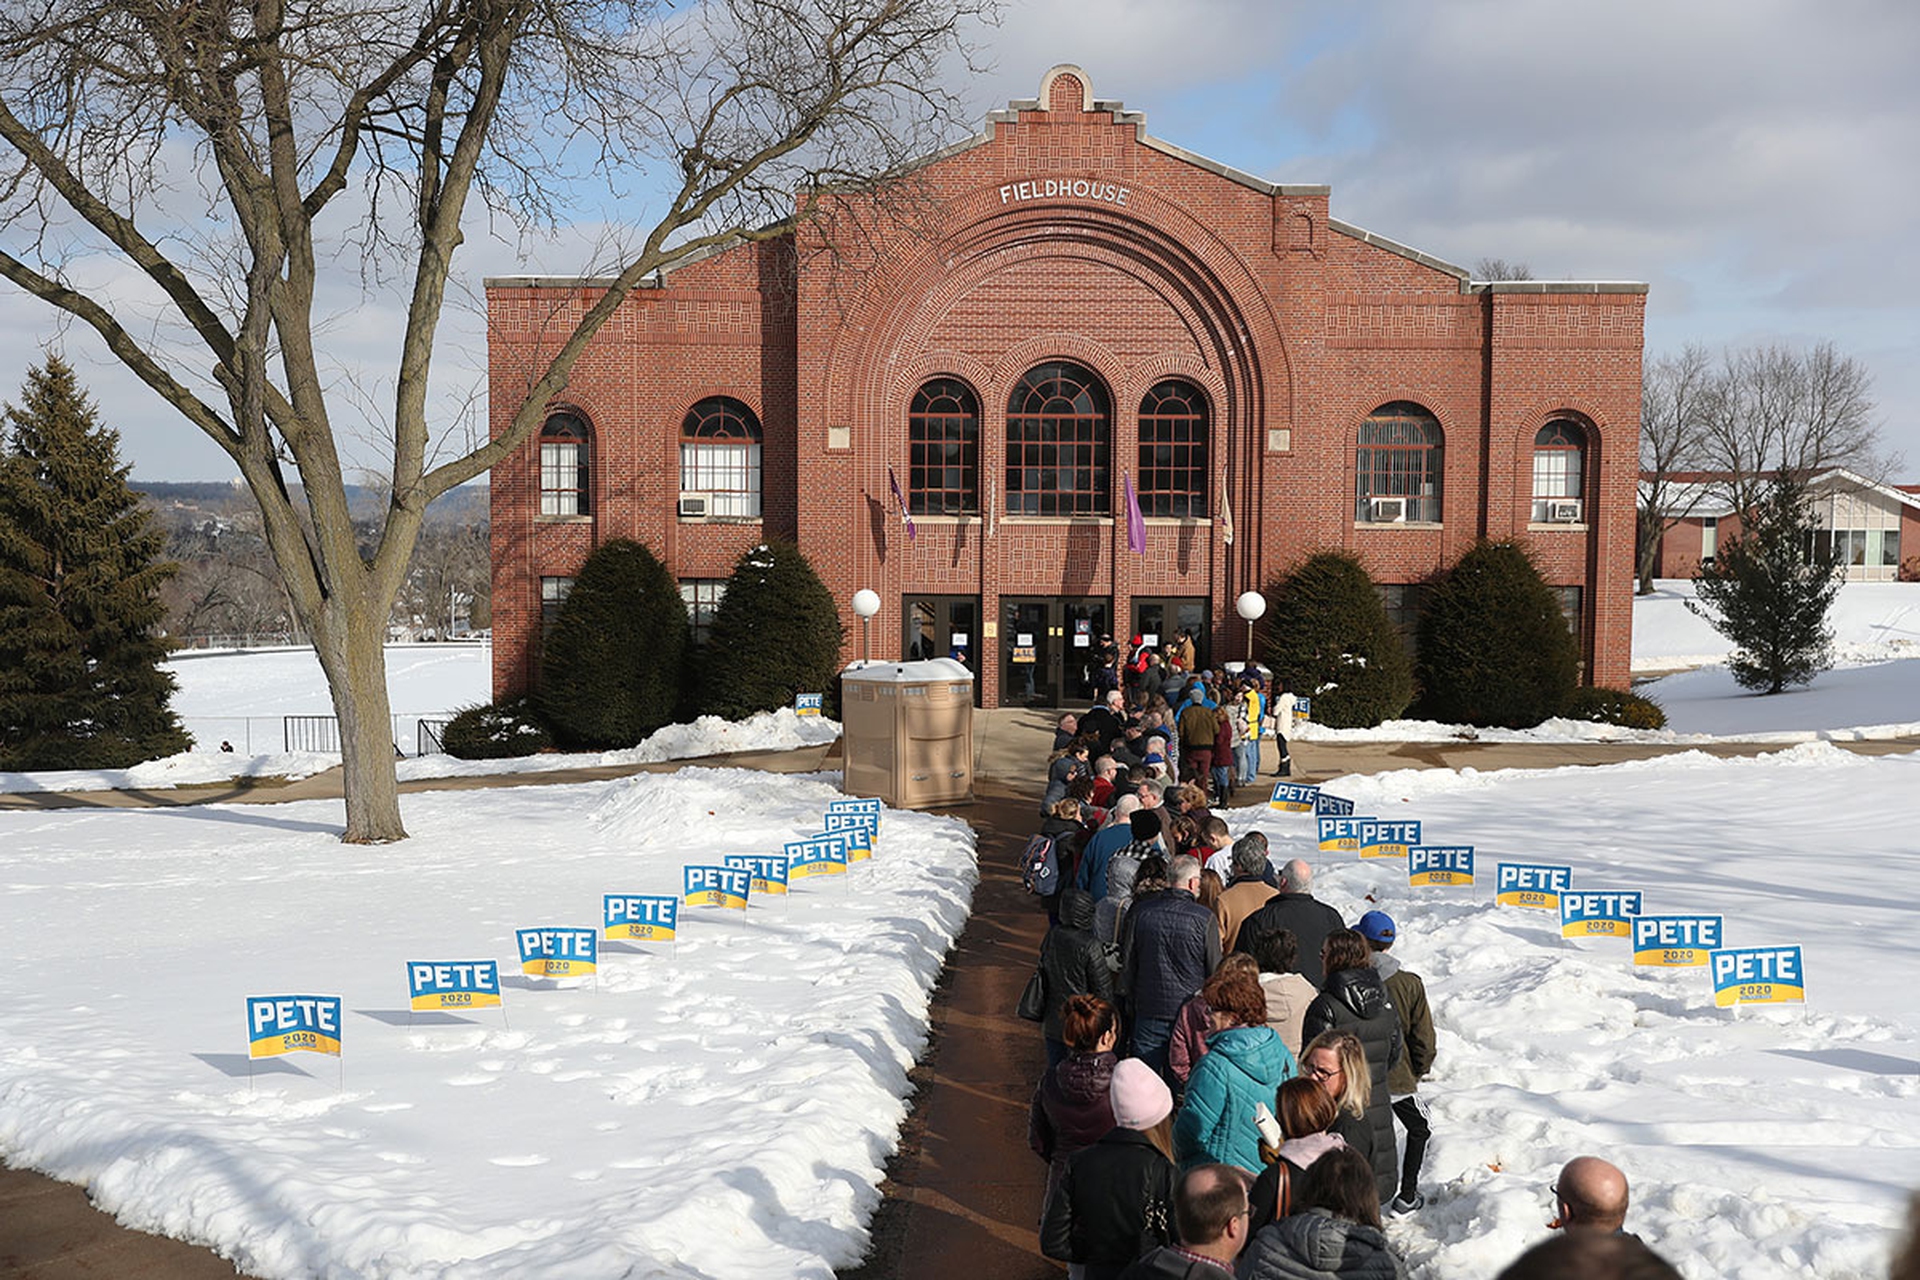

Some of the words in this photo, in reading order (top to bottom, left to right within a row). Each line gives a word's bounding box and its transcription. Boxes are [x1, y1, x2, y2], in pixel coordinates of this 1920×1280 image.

[1000, 180, 1130, 206] FIELDHOUSE
[798, 697, 821, 707] PETE
[1275, 784, 1318, 802] PETE
[1321, 820, 1360, 838] PET
[1362, 824, 1418, 843] PETE
[786, 840, 843, 861] PETE
[1411, 849, 1470, 870] PETE
[688, 868, 747, 894] PETE
[1501, 866, 1567, 890] PETE
[1520, 893, 1546, 901] 2020
[1563, 895, 1637, 919] PETE
[608, 899, 674, 923] PETE
[629, 925, 654, 934] 2020
[1587, 921, 1615, 930] 2020
[1638, 920, 1717, 946] PETE
[521, 932, 593, 957] PETE
[1663, 950, 1694, 960] 2020
[412, 965, 494, 991] PETE
[1715, 951, 1796, 984] PETE
[441, 993, 472, 1002] 2020
[1739, 985, 1772, 995] 2020
[253, 1000, 337, 1033] PETE
[283, 1033, 316, 1044] 2020
